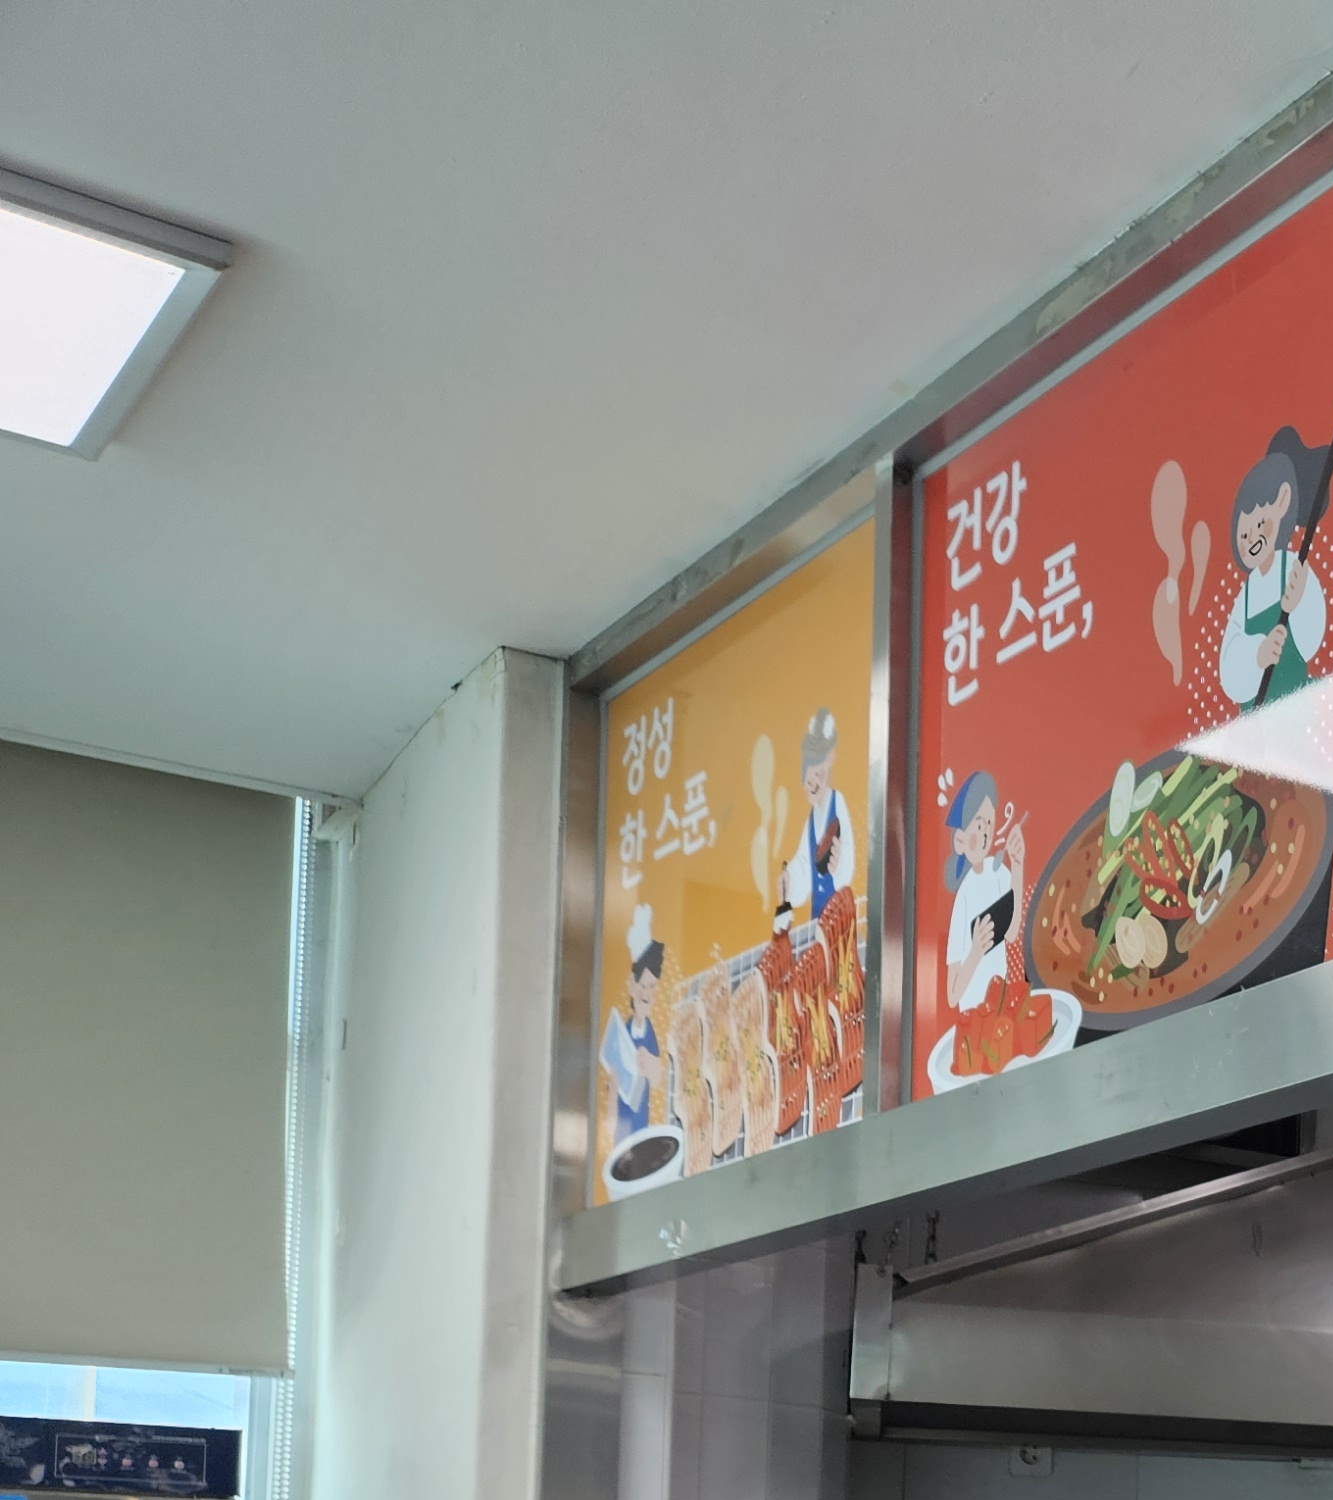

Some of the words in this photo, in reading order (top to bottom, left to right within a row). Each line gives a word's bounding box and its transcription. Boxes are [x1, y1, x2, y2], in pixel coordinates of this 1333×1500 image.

[946, 461, 1028, 591] 건강
[942, 604, 986, 707] 한
[996, 542, 1094, 664] 스푼,
[622, 697, 675, 796] 정성
[618, 809, 649, 889] 한
[652, 771, 717, 860] 스푼,
